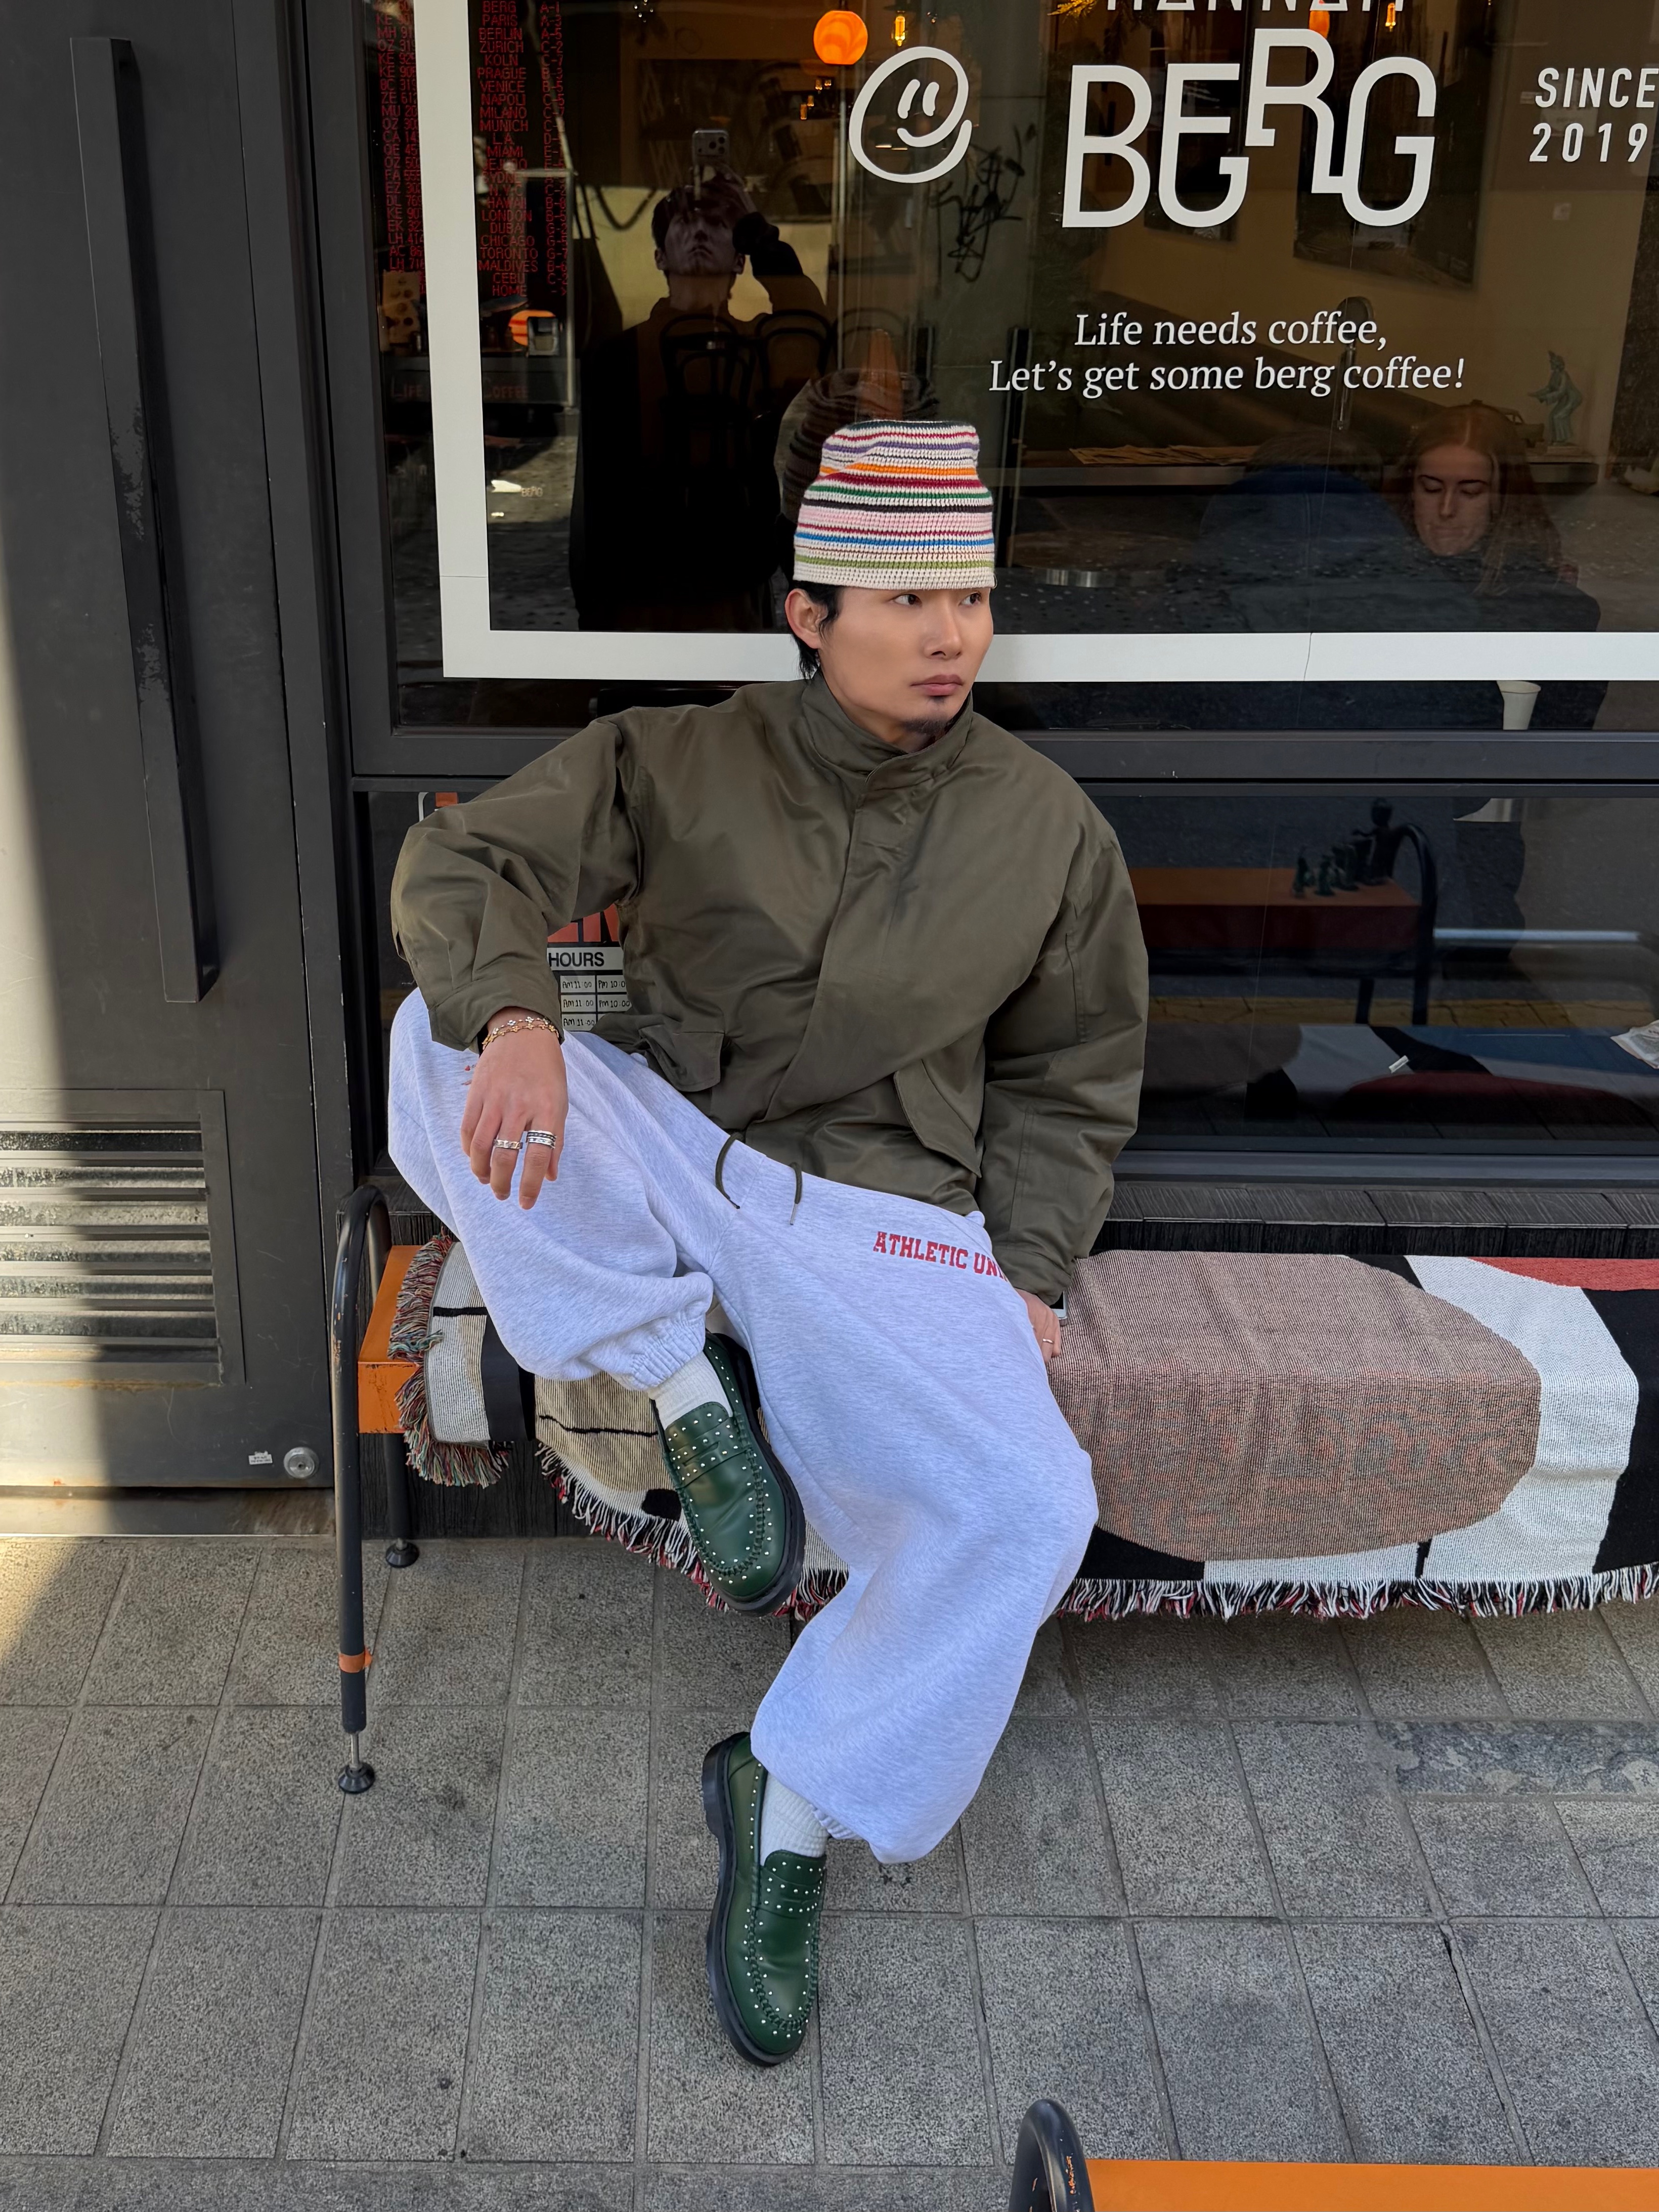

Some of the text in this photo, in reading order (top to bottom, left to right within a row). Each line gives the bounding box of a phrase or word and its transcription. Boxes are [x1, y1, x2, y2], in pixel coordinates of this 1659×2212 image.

[483, 1, 516, 13] BERG
[540, 2, 560, 13] A-1
[482, 15, 518, 26] PARIS
[377, 27, 397, 38] MH
[478, 28, 522, 40] BERLIN
[542, 28, 562, 39] A-5
[377, 39, 395, 52] OZ
[479, 41, 523, 53] ZURICH
[541, 41, 563, 53] C-2
[378, 53, 395, 64] KE
[484, 54, 518, 66] KOLN
[542, 54, 563, 66] C-7
[379, 66, 396, 77] KE
[477, 67, 527, 79] PRAGUE
[480, 80, 526, 93] VENICE
[543, 80, 563, 93] B-5
[1535, 67, 1659, 108] SINCE
[381, 92, 397, 104] ZE
[481, 94, 526, 106] NAPOLI
[382, 105, 400, 116] MU
[479, 107, 527, 118] MILANO
[382, 118, 399, 130] OZ
[479, 120, 529, 132] MUNICH
[1063, 28, 1436, 228] BERG
[382, 131, 401, 143] CA
[405, 131, 419, 143] 14
[1530, 122, 1648, 162] 2019
[405, 144, 419, 156] 45
[487, 145, 523, 157] MIAMI
[384, 157, 401, 168] OZ
[385, 169, 402, 181] FA
[386, 182, 402, 194] EZ
[386, 195, 402, 206] DL
[387, 207, 403, 219] KE
[407, 207, 423, 219] 90
[481, 209, 532, 222] LONDON
[387, 220, 404, 232] EK
[490, 223, 525, 234] DUBAI
[388, 233, 403, 245] LH
[481, 235, 535, 247] CHICAGO
[389, 245, 406, 257] AC
[479, 247, 538, 259] TORONTO
[390, 258, 404, 270] LH
[478, 260, 538, 272] MALDIVES
[493, 273, 526, 284] CEBU
[492, 285, 528, 297] HOME
[1074, 311, 1386, 351] Life needs coffee,
[1082, 362, 1140, 399] get
[1150, 365, 1244, 390] some
[1255, 357, 1335, 397] berg
[1343, 356, 1464, 388] coffee!
[548, 951, 604, 967] HOURS
[610, 980, 626, 988] 10:0
[873, 1231, 1008, 1282] ATHLETIC UN
